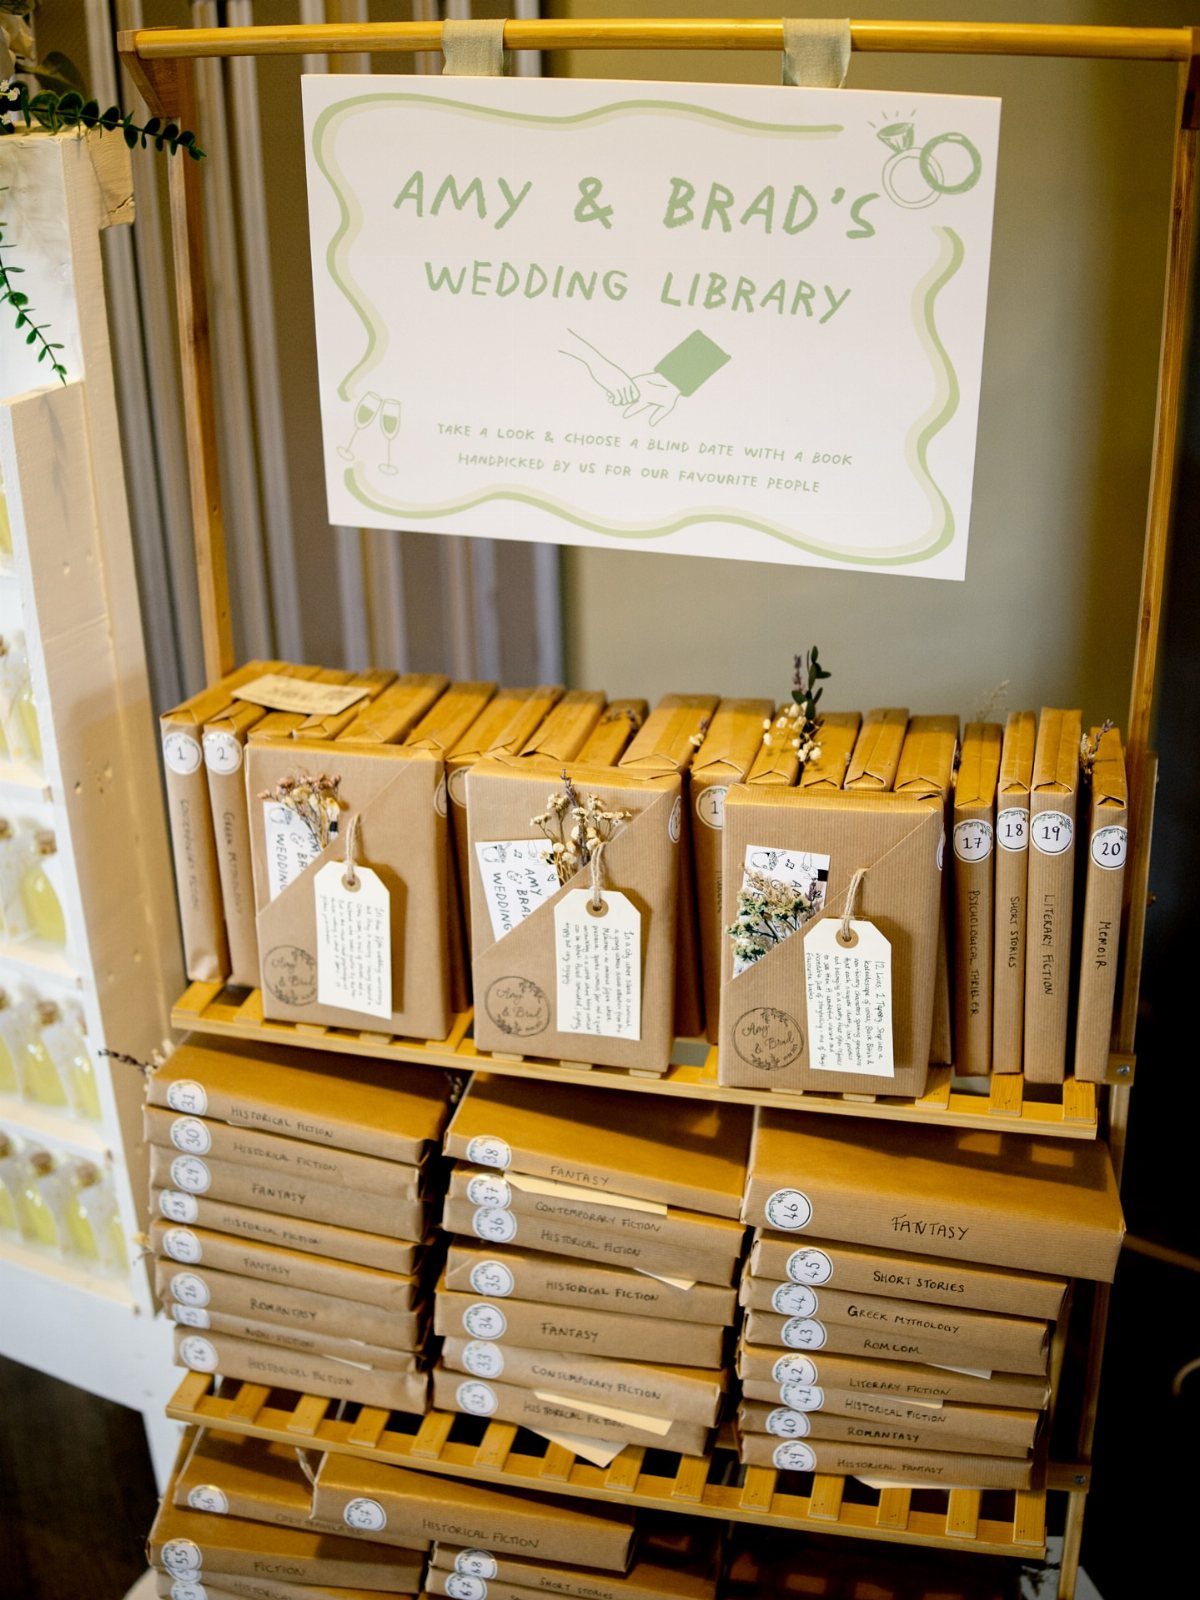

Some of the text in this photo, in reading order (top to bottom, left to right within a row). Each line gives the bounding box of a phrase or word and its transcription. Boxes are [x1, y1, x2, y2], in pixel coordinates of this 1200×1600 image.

[393, 170, 880, 240] AMY & BRAD'S
[424, 260, 852, 325] WEDDING LIBRARY
[438, 423, 853, 465] TAKE A LOOK & CHOOSE A BLIND DATE WITH A BOOK
[458, 453, 820, 493] HANDPICKED BY US FOR OUR FAVOURITE PEOPLE
[176, 748, 187, 761] 1
[217, 747, 229, 760] 2
[962, 836, 983, 850] 17
[1005, 823, 1024, 838] 18
[1042, 825, 1061, 842] 19
[1101, 842, 1122, 857] 20
[524, 868, 543, 896] AMY
[493, 872, 514, 931] WEDDING
[1008, 896, 1021, 968] SHORT STORIES
[1042, 894, 1056, 996] LITERARY FICTION
[875, 961, 886, 970] 12
[969, 968, 981, 1018] THRILLER
[181, 1091, 335, 1139] 31 HISTORICAL FICTION
[185, 1127, 201, 1146] 30
[296, 1156, 339, 1174] FICTION
[482, 1147, 611, 1187] 38 FANTASY
[186, 1166, 308, 1205] 29 FANTASY
[172, 1200, 187, 1218] 28
[484, 1186, 662, 1234] 37 CONTEMPORARY FICTION
[785, 1202, 972, 1242] 46 FANTASY
[488, 1216, 644, 1258] 36 HISTORICAL FICTION
[242, 1257, 292, 1277] FANTASY
[803, 1260, 966, 1294] 45 SHORT STORIES
[484, 1272, 661, 1303] 35 HISTORICAL FICTION
[250, 1298, 319, 1322] ROMANTASY
[792, 1294, 961, 1336] 44 GREEK MYTHOLOGY
[478, 1314, 601, 1344] 34 FANTASY
[798, 1326, 814, 1345] 43
[248, 1357, 309, 1380] HISTORICAL
[311, 1369, 355, 1388] FICTION
[476, 1354, 492, 1371] 33
[616, 1382, 663, 1401] FICTION
[792, 1364, 952, 1397] 42 LITERARY FICTION
[522, 1400, 584, 1422] HISTORICAL
[800, 1386, 948, 1424] 41 HISTORICAL FICTION
[785, 1418, 920, 1444] 40 ROMANTASY
[789, 1449, 944, 1477] 39 HISTORICAL FANTASY
[358, 1509, 373, 1526] 57
[422, 1518, 490, 1542] HISTORICAL
[491, 1530, 542, 1550] FICTION
[174, 1549, 307, 1578] 55 FICTION
[539, 1576, 571, 1592] SHORT
